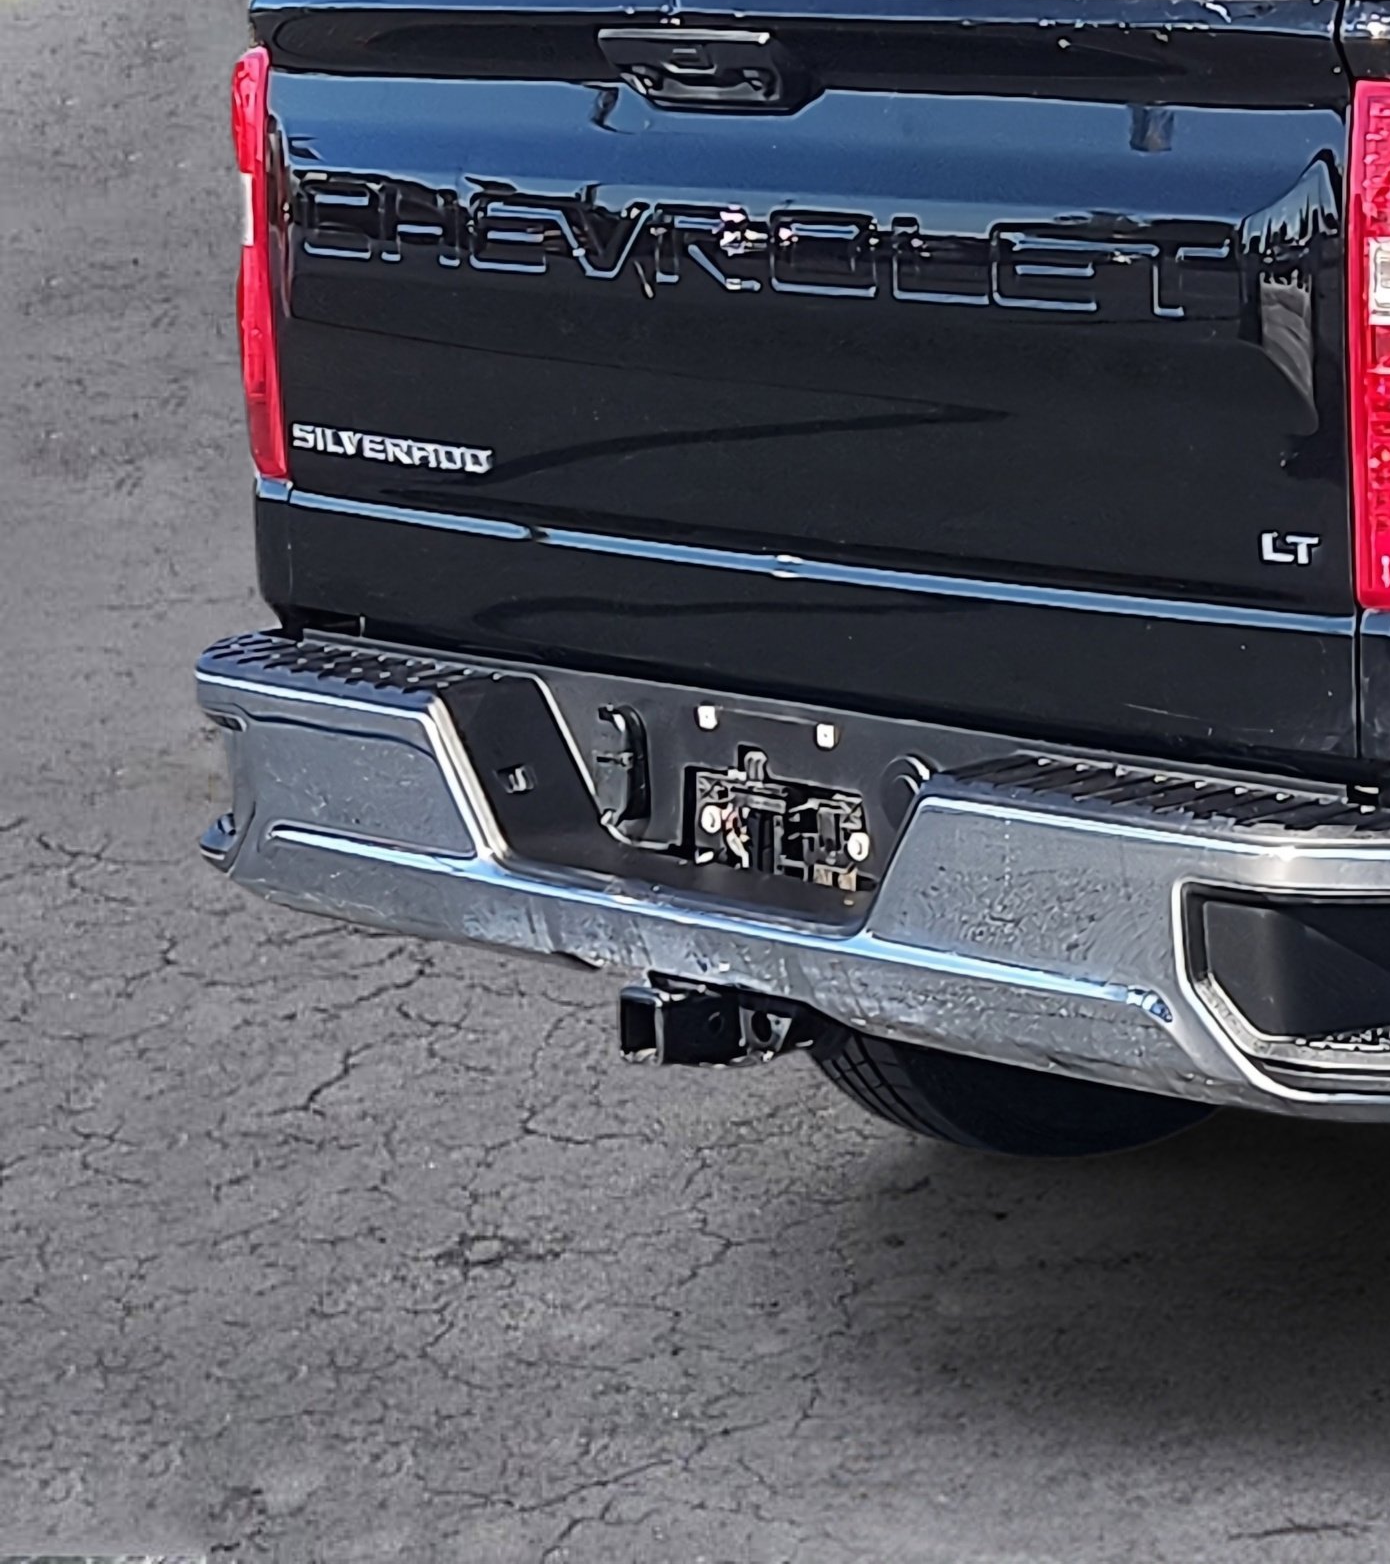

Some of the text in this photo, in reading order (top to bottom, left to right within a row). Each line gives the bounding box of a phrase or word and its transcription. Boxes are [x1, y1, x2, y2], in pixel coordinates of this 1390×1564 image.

[298, 174, 1240, 318] CHEVROLET
[292, 423, 493, 474] SILVERADO
[1261, 531, 1320, 565] LT
